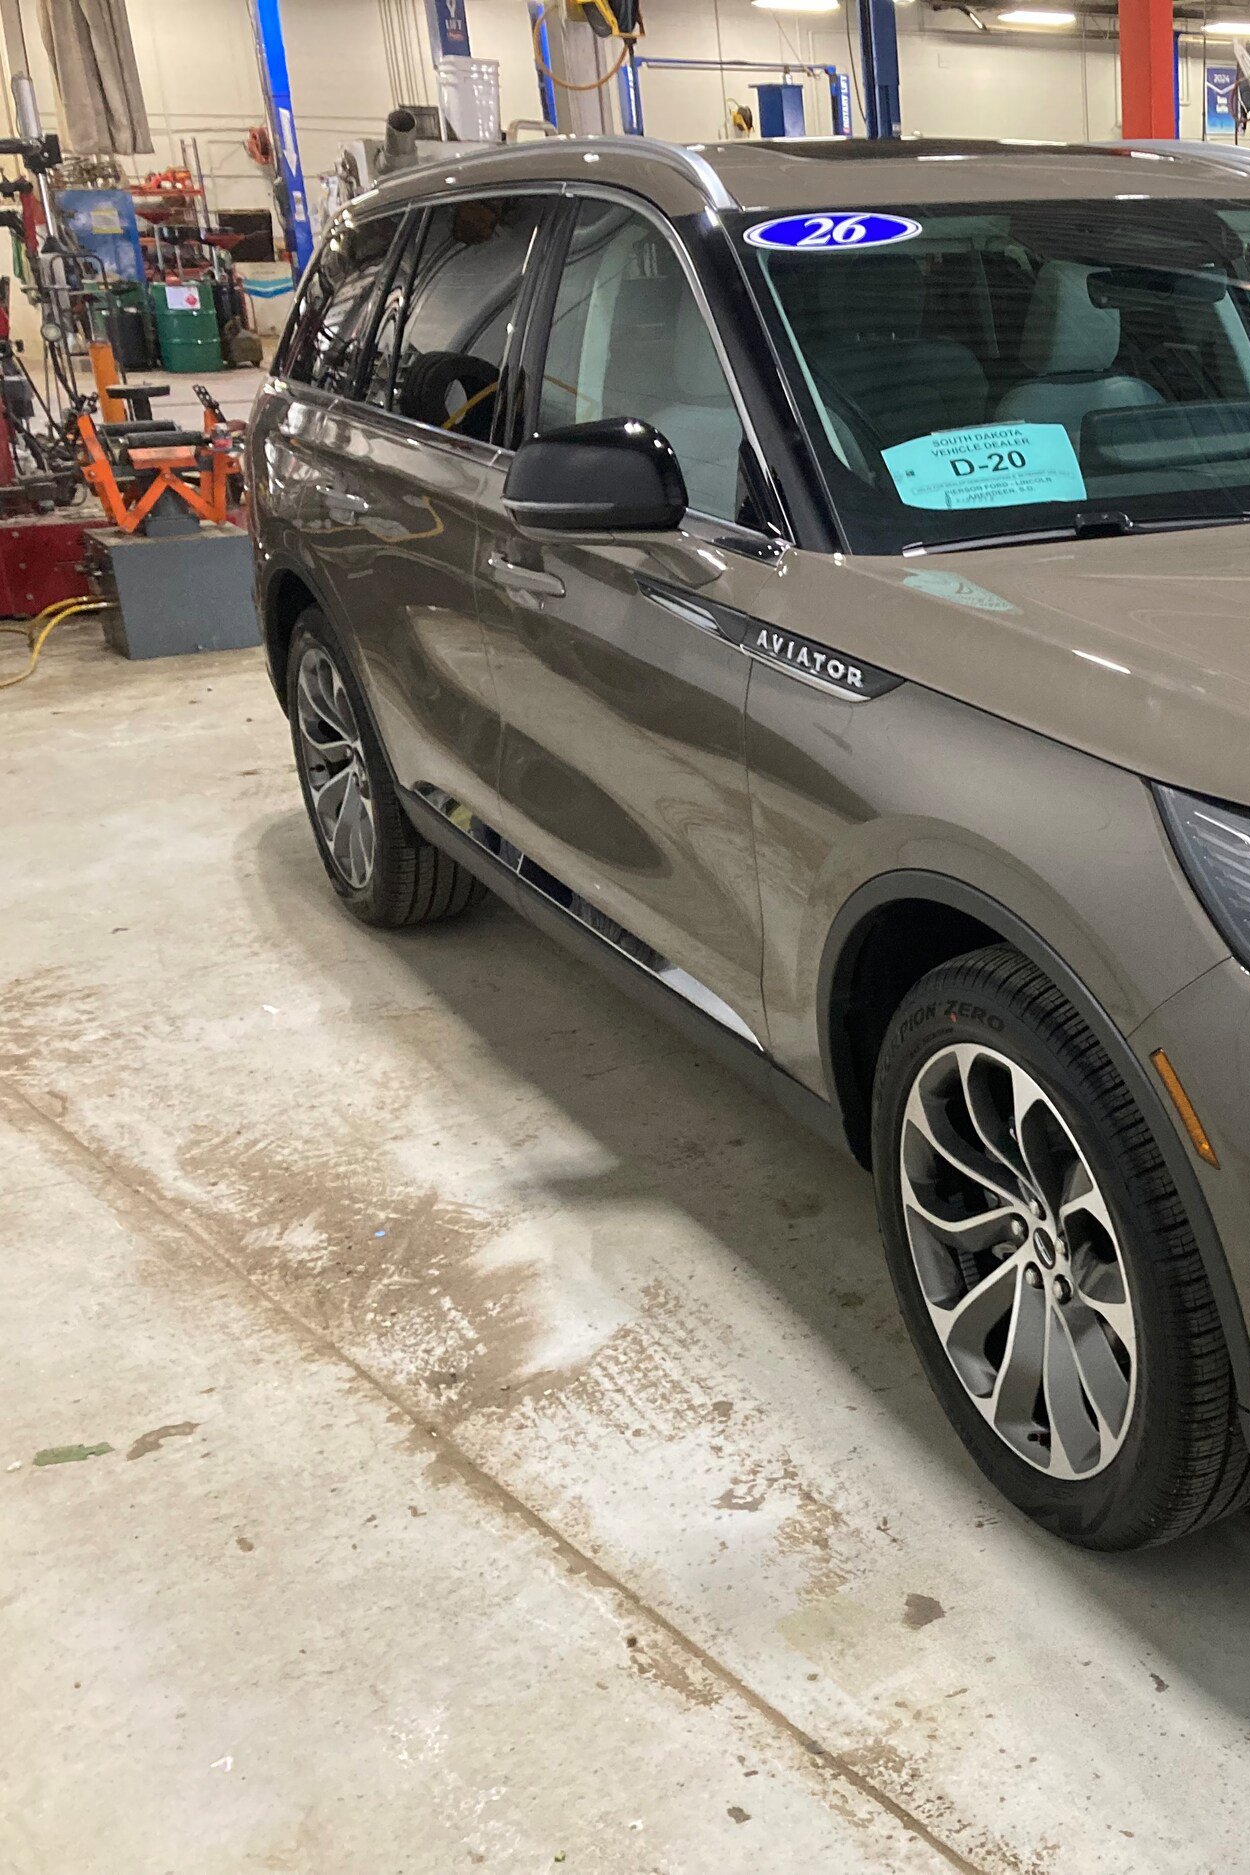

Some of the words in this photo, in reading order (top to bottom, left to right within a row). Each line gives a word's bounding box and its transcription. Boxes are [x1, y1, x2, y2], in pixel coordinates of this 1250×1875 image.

[842, 95, 850, 128] ROTARY
[797, 214, 871, 246] 26
[931, 443, 981, 457] VEHICLE
[984, 437, 1031, 449] DEALER
[932, 434, 973, 448] SOUTH
[975, 429, 1023, 441] DAKOTA
[950, 449, 1027, 477] D-20
[945, 484, 983, 497] PIERSON
[984, 481, 1009, 490] FORD
[1015, 476, 1053, 487] LINCOLN
[757, 629, 864, 688] AVIATOR
[944, 999, 1006, 1033] ZERO
